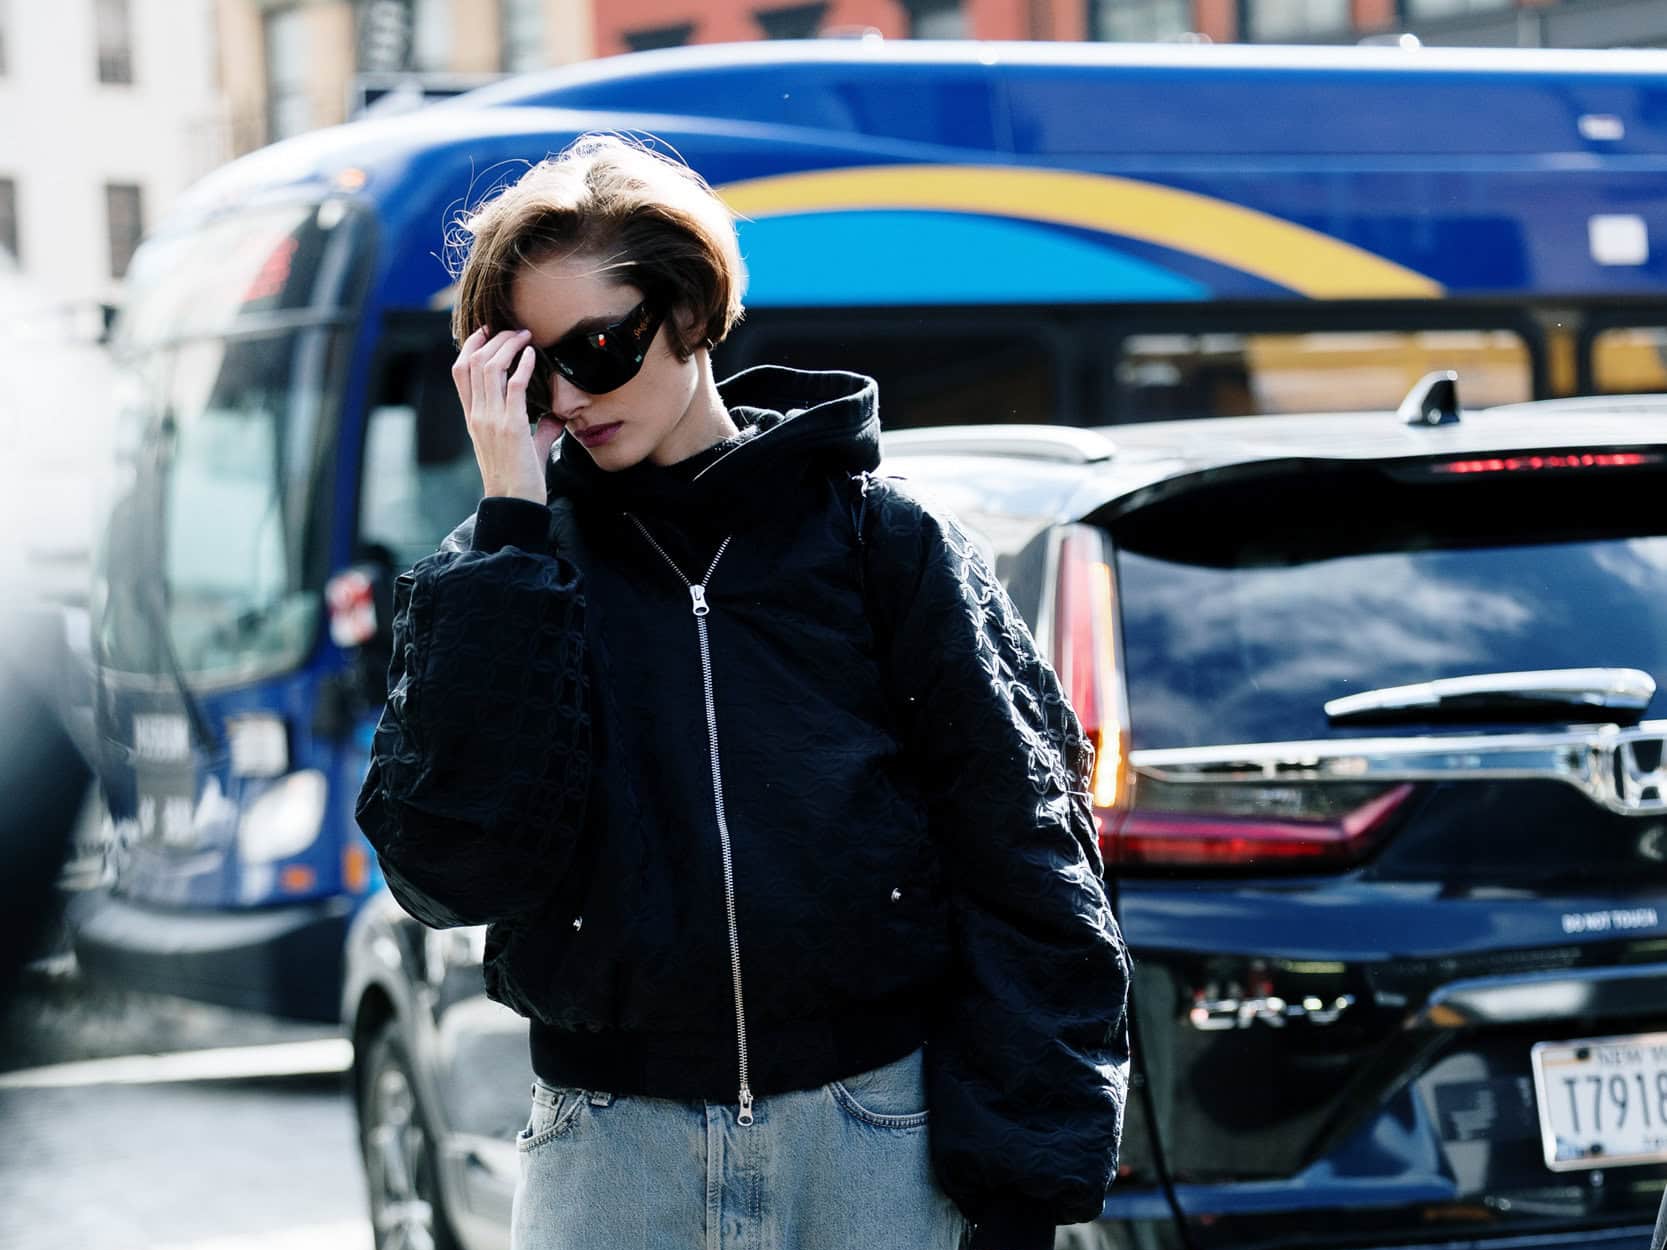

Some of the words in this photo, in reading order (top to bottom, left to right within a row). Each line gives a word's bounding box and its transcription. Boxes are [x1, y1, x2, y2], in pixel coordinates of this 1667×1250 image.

[1561, 913, 1585, 933] DO
[1585, 911, 1611, 931] NOT
[1611, 908, 1658, 929] TOUCH
[1190, 995, 1355, 1030] CR-V
